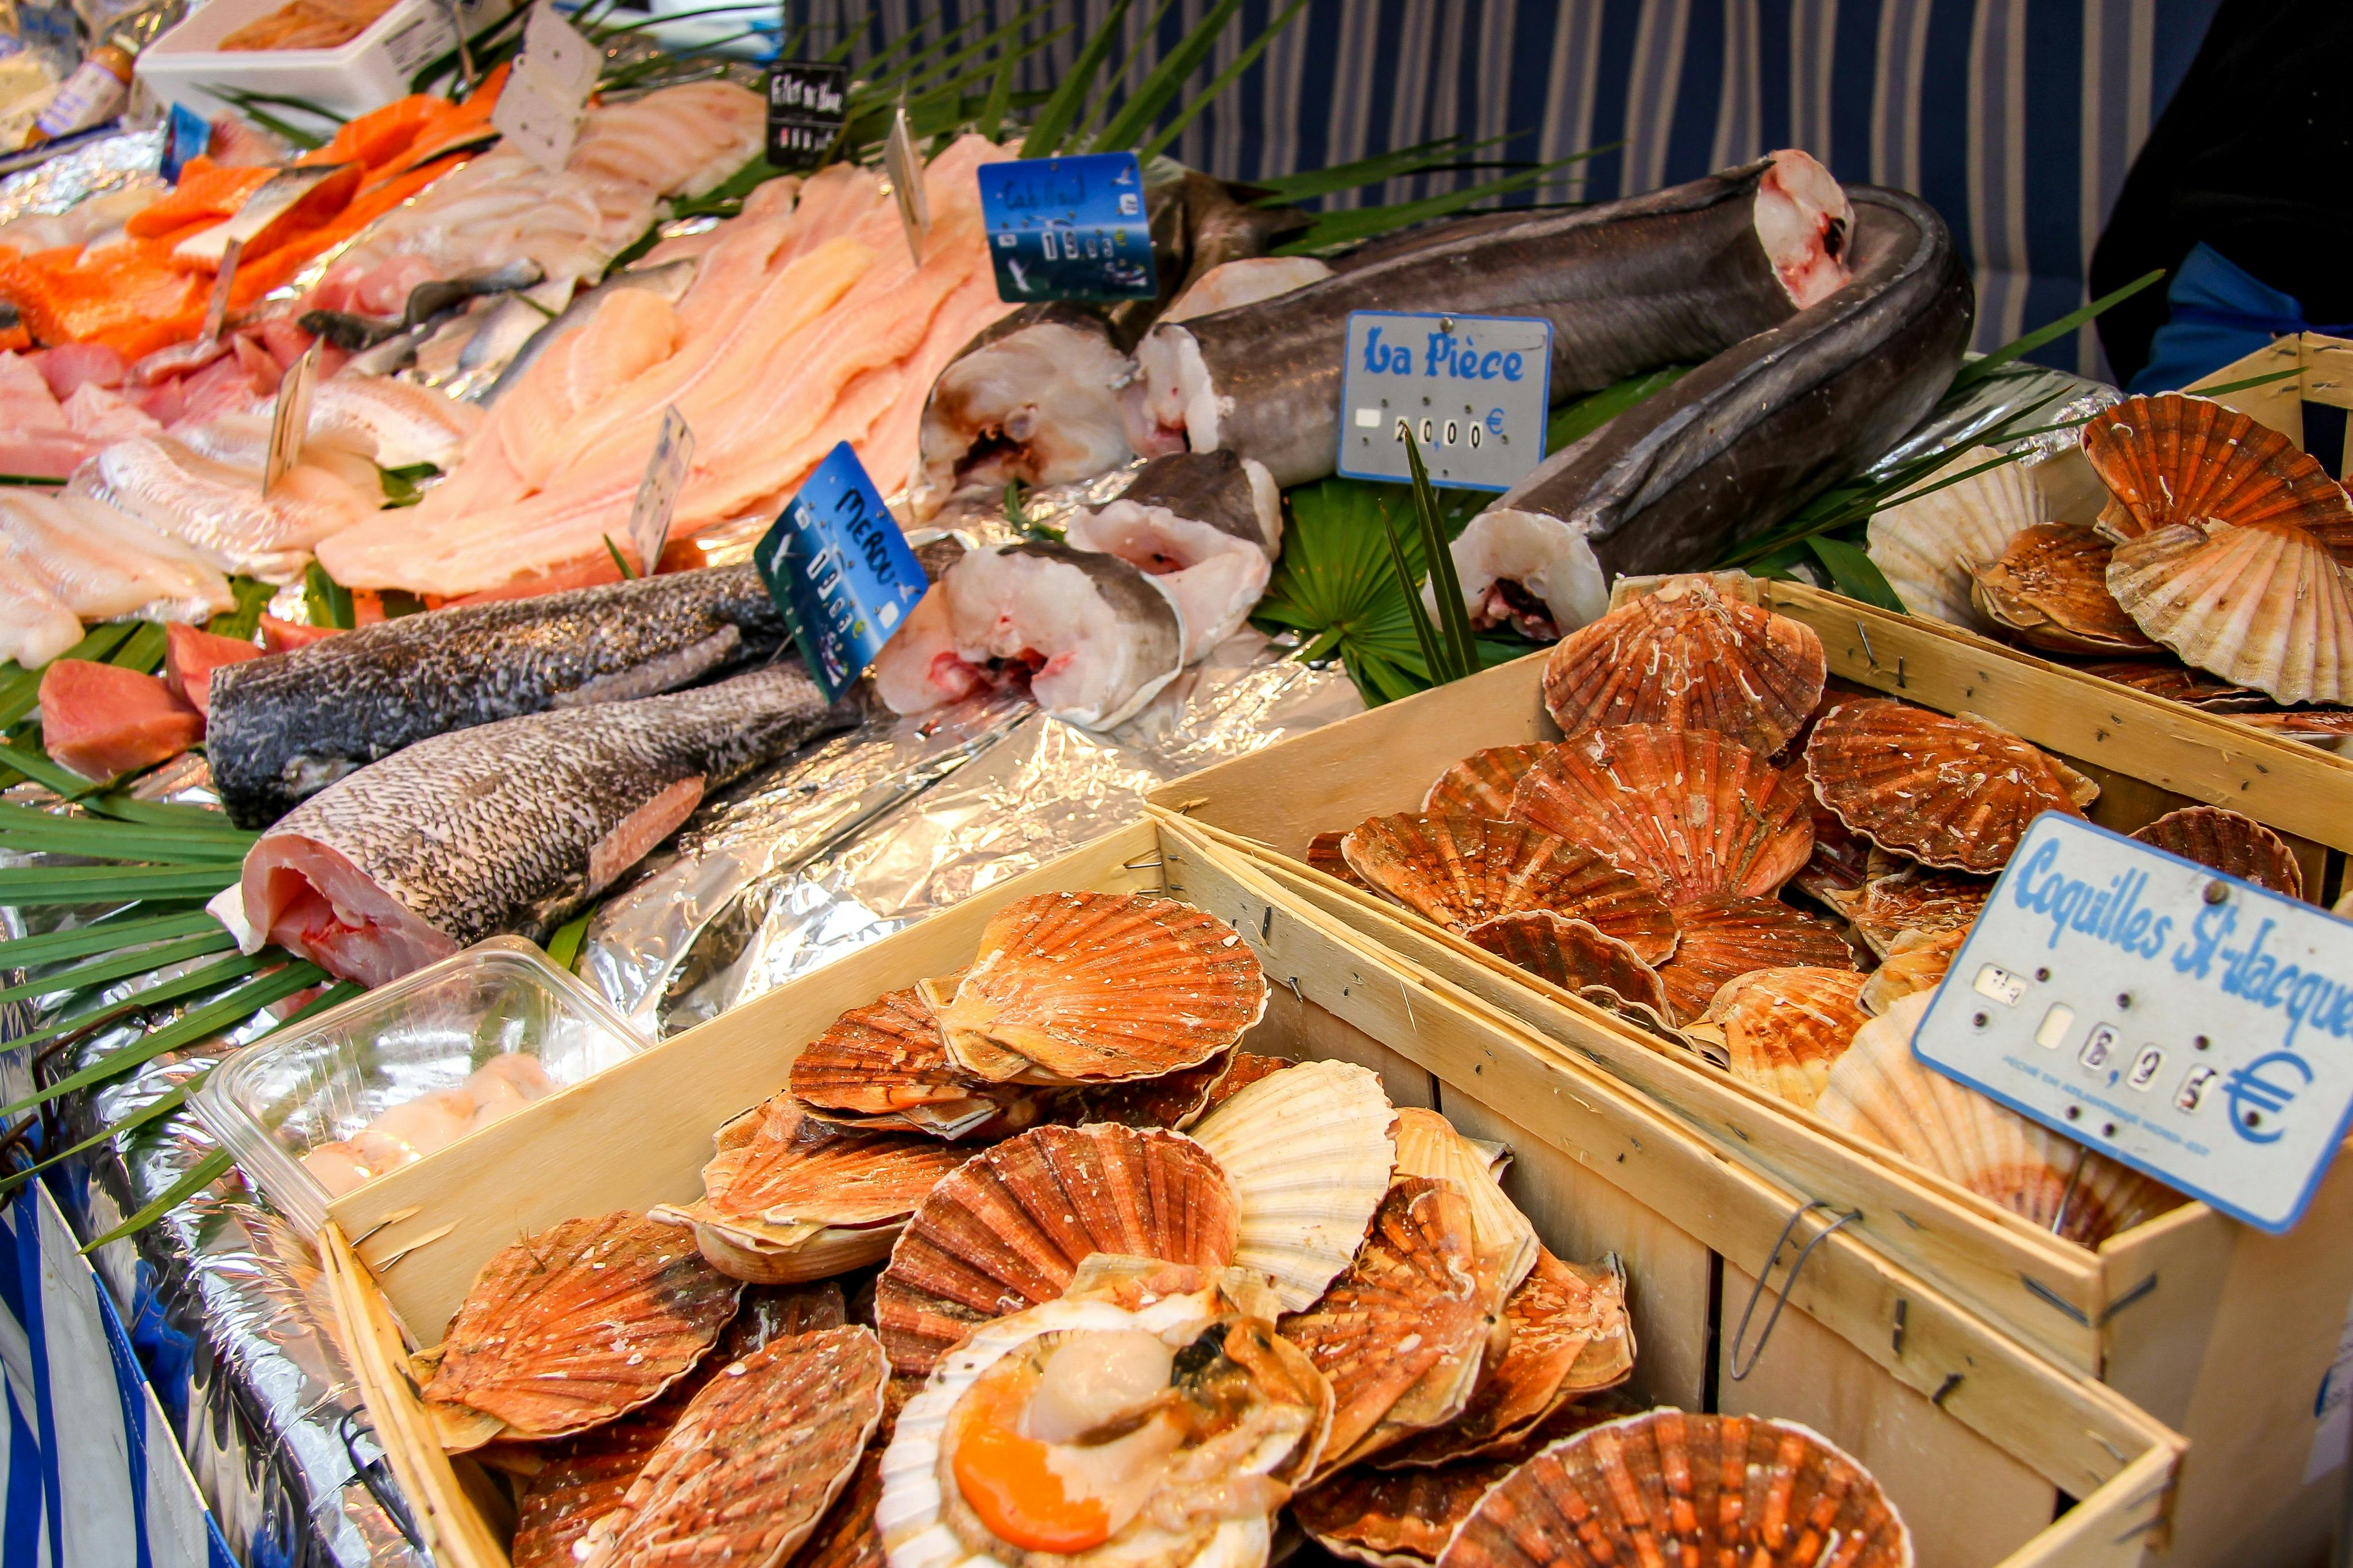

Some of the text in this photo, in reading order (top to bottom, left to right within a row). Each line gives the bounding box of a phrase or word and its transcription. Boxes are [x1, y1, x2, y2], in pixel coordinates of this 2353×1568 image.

[1365, 326, 1523, 382] La Pièce
[835, 489, 896, 585] MEROU
[2012, 837, 2353, 1048] Coquilles St-Jacque
